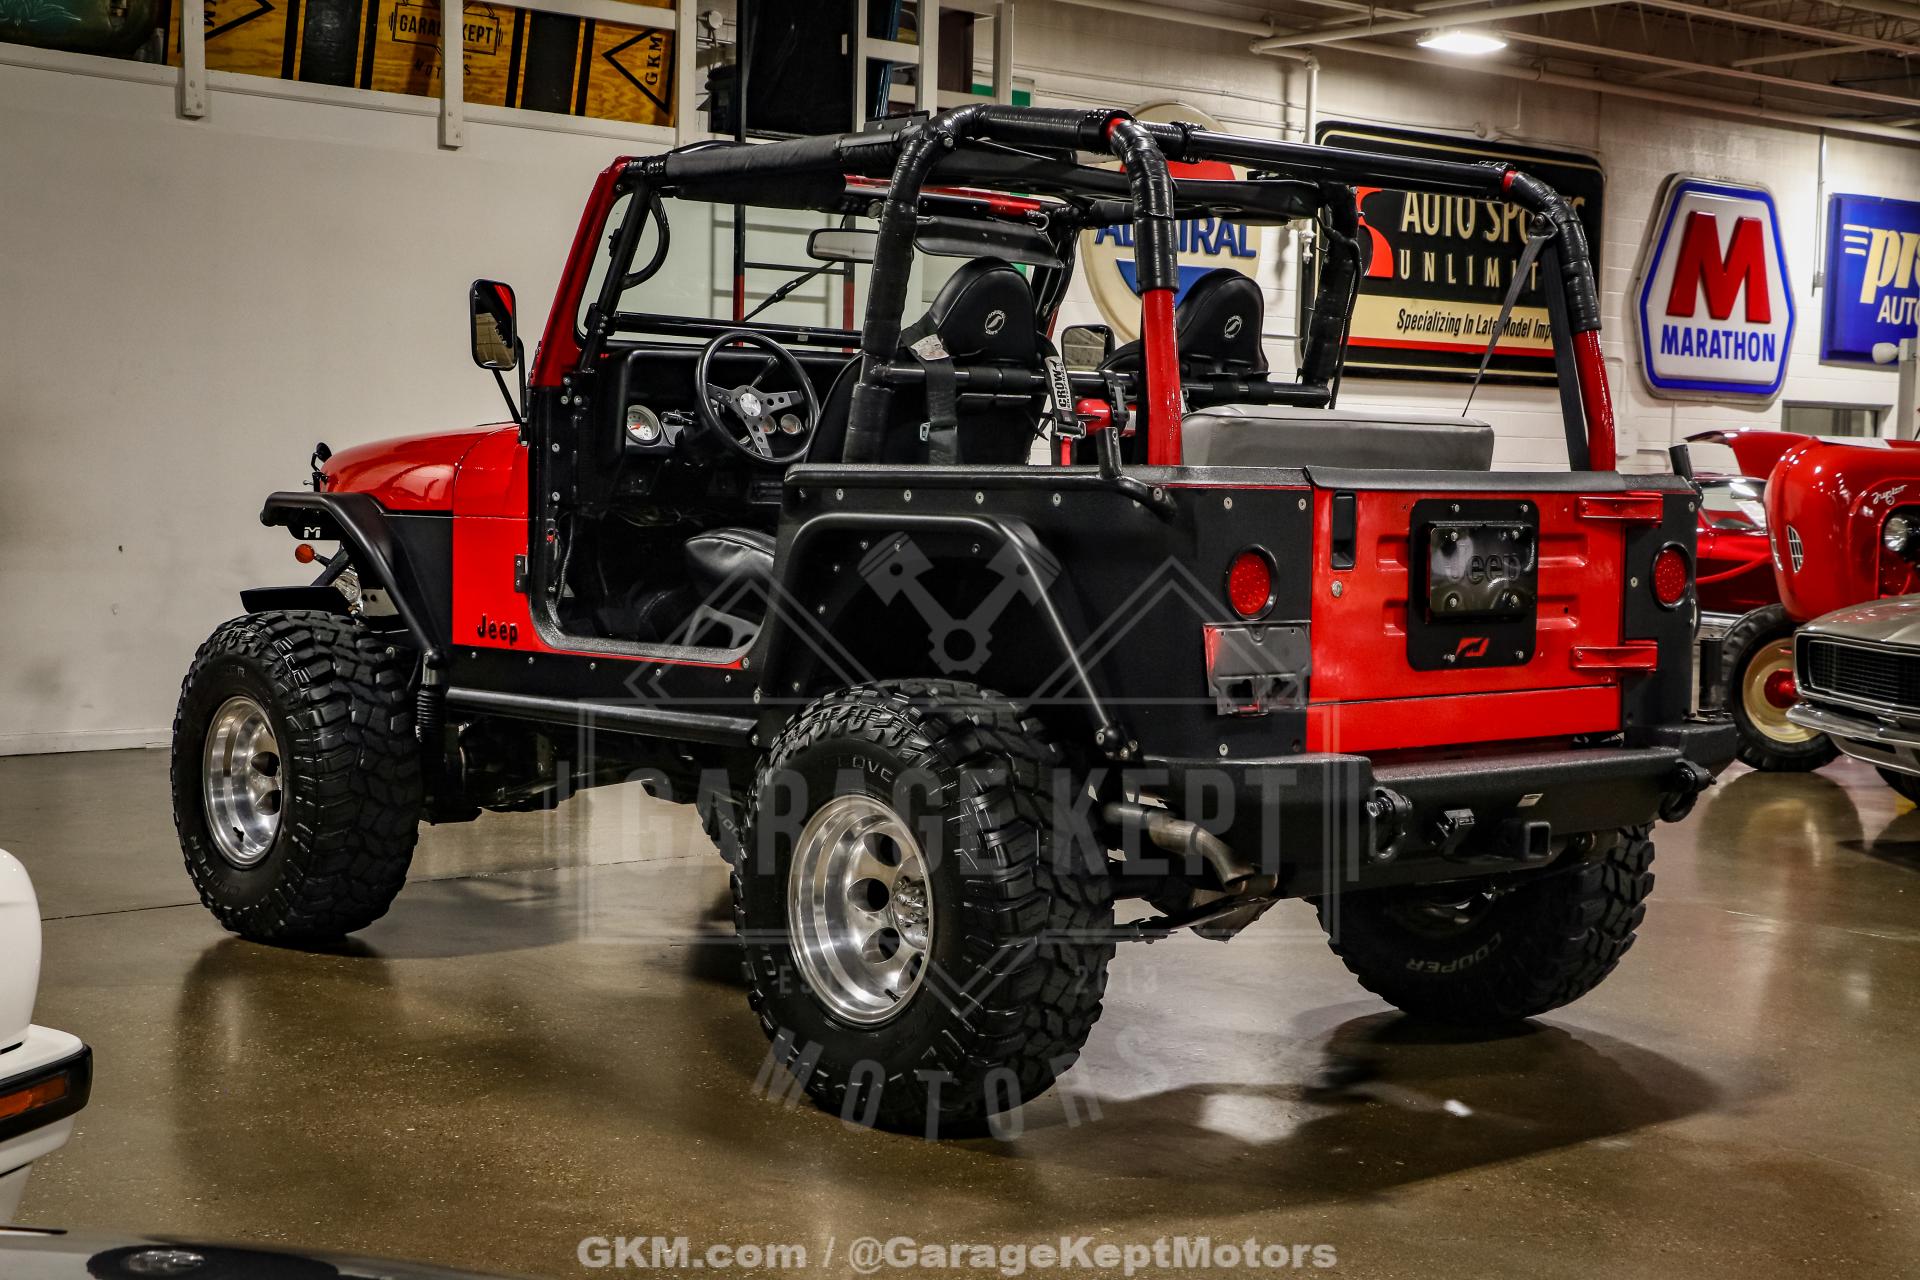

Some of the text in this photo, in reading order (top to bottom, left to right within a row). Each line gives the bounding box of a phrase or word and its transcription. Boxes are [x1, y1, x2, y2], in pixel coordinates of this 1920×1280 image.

[645, 35, 664, 86] GKM
[1399, 248, 1539, 291] UNLIMIT
[1666, 210, 1772, 325] M
[1397, 307, 1462, 338] Specializing
[1463, 314, 1474, 334] In
[1533, 321, 1551, 340] Imp
[1660, 324, 1776, 363] MARATHON
[1051, 368, 1067, 408] CROW
[477, 613, 518, 646] Jeep
